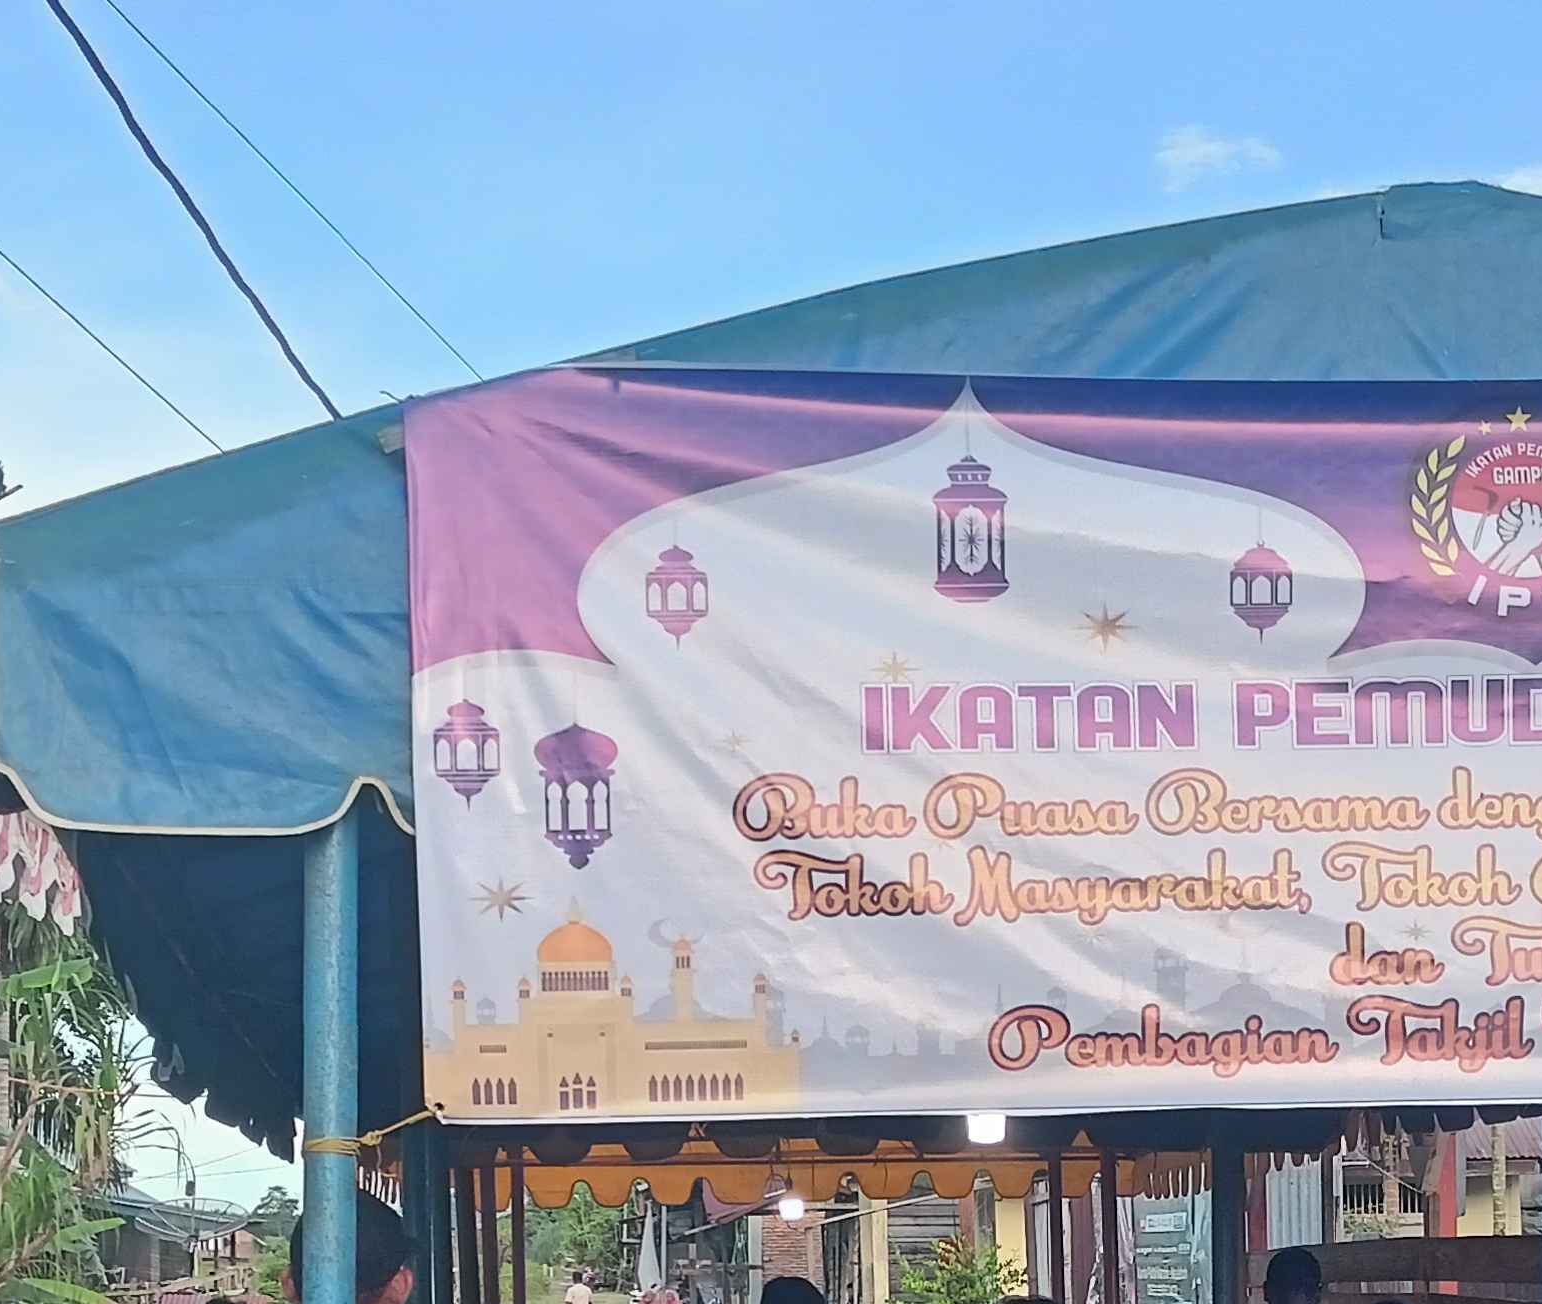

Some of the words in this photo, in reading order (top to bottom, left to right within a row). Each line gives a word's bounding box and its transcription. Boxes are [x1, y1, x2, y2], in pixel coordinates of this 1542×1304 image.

[1465, 443, 1512, 478] IKATAN
[861, 681, 1198, 752] IKATAN
[733, 772, 916, 841] Buka
[923, 772, 1139, 840] Puasa
[1145, 767, 1429, 834] Bersama
[754, 848, 954, 922] Tokoh
[954, 844, 1311, 926] Masyarakat,
[1321, 841, 1522, 912] Tokoh
[1329, 921, 1444, 985] dan
[988, 1004, 1339, 1078] Pembagian
[1347, 995, 1535, 1073] Takjil
